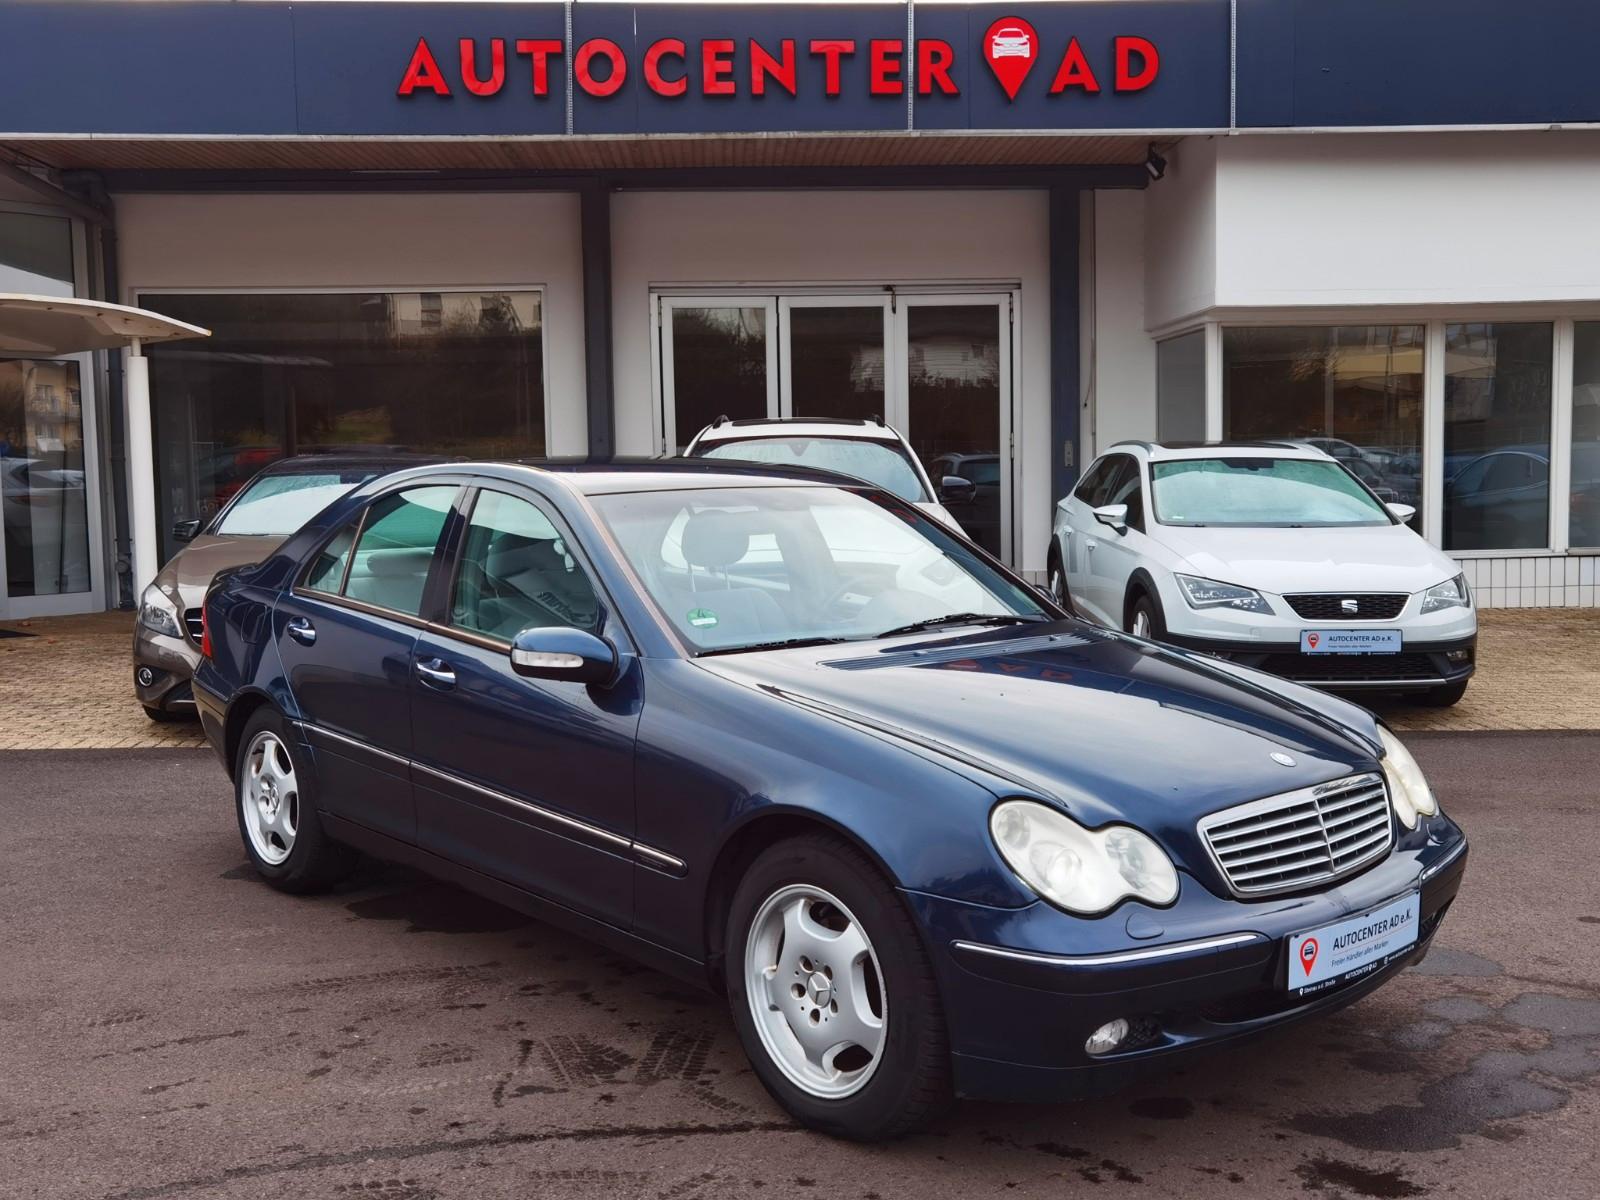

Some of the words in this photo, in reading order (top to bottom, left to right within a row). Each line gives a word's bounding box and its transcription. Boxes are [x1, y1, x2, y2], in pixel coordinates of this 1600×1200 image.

[397, 37, 961, 98] AUTOCENTER
[1049, 36, 1161, 96] AD
[1333, 920, 1387, 951] AUTOCENTER
[1389, 914, 1400, 930] AD
[1401, 908, 1413, 924] e.K.
